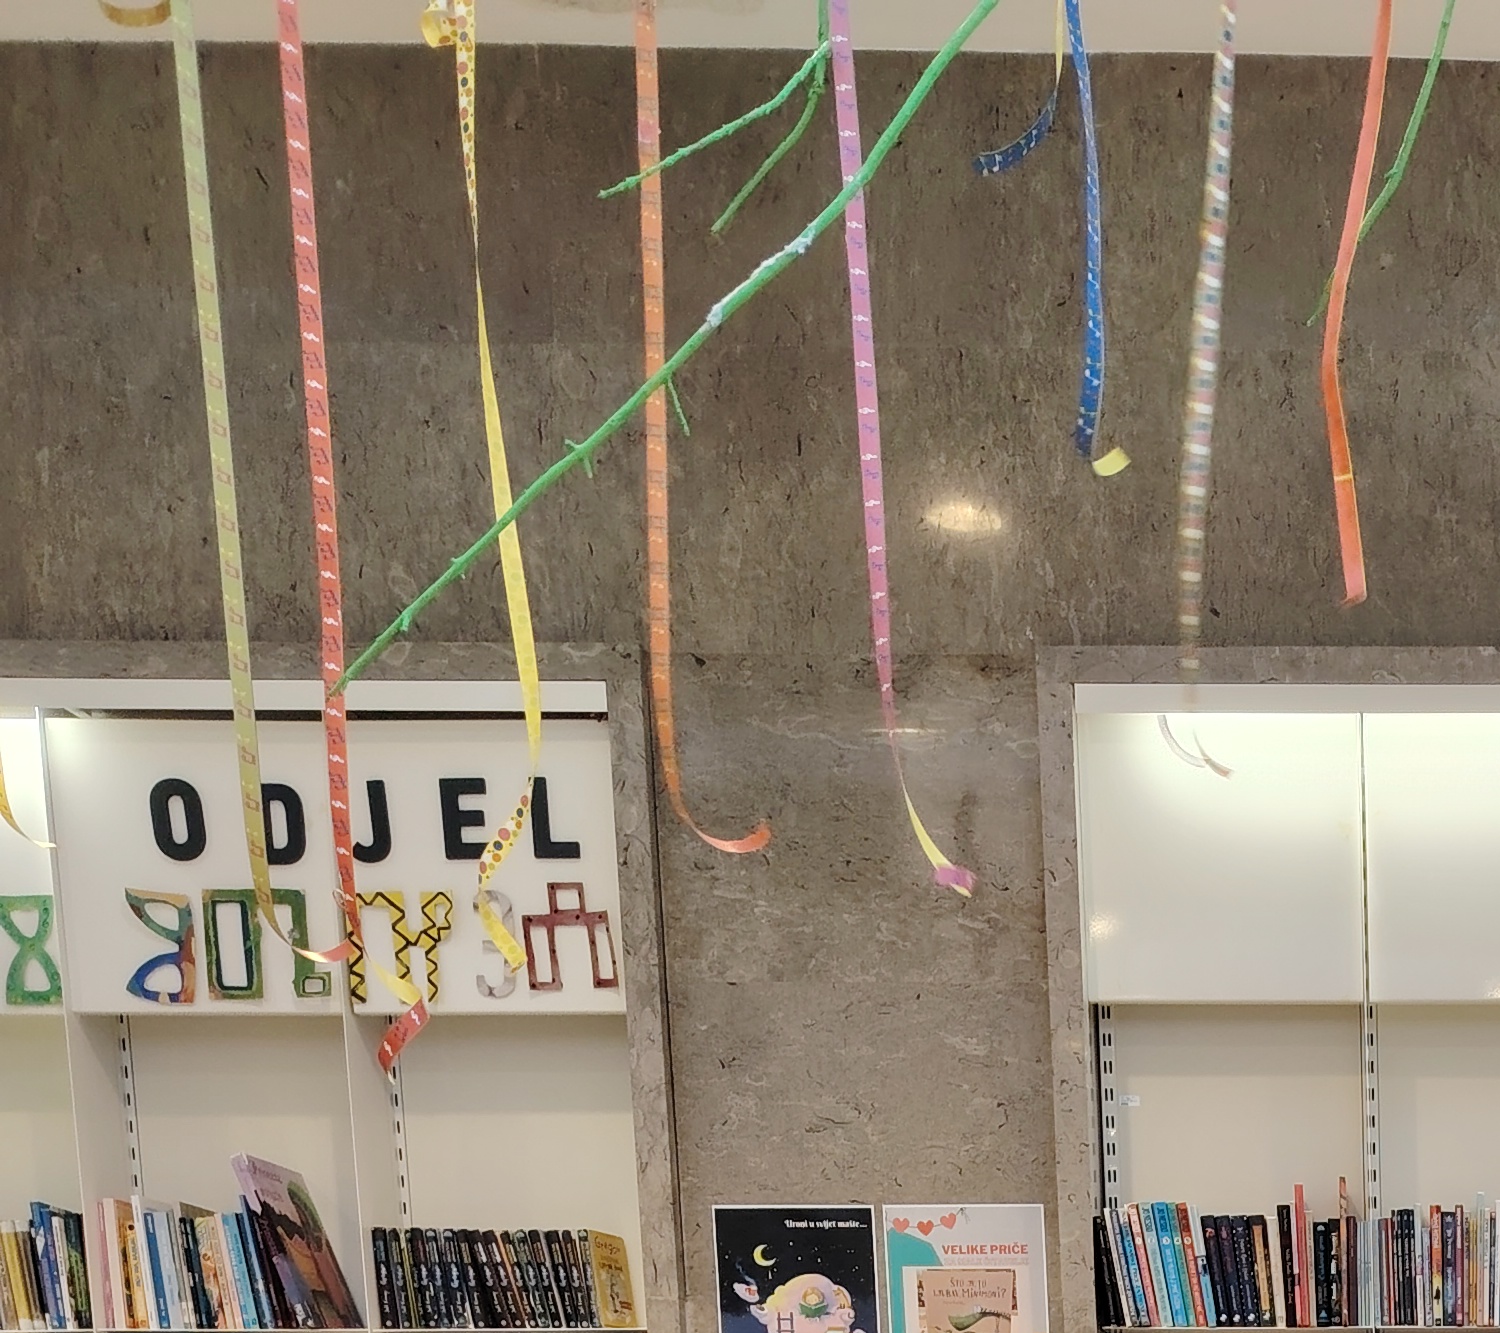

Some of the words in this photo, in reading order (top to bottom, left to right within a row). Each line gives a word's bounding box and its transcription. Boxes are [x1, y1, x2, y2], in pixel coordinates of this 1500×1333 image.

[149, 777, 581, 865] ODJEL
[942, 1244, 988, 1255] VELIKE
[990, 1242, 1028, 1255] PRIČE
